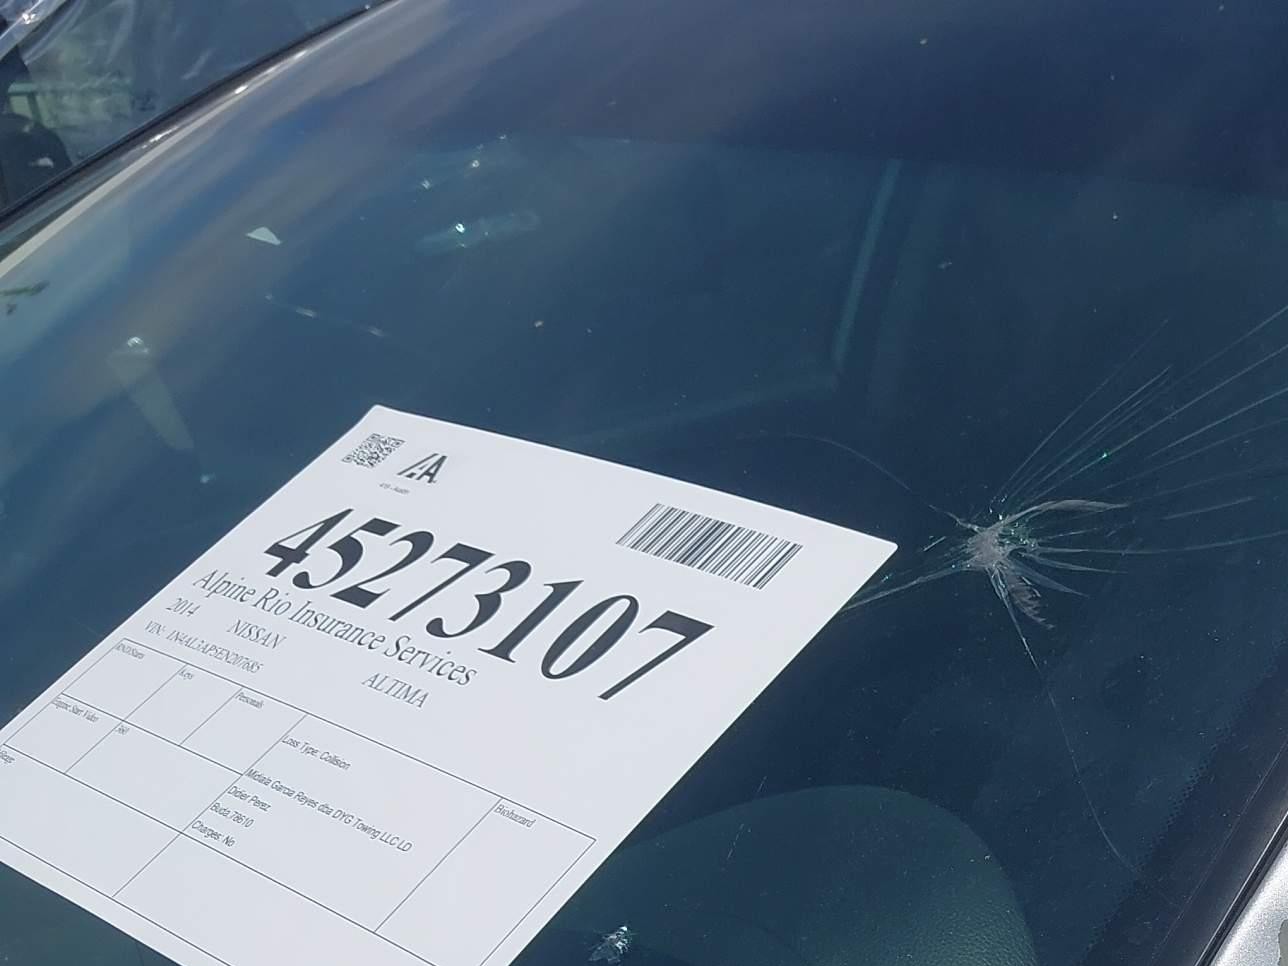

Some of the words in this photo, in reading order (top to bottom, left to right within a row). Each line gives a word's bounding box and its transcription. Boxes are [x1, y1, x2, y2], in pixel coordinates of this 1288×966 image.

[263, 507, 715, 701] 45273107
[145, 620, 166, 636] VIN:
[193, 569, 256, 606] Alpine
[252, 588, 291, 616] Rio
[288, 601, 385, 650] Insurance
[384, 635, 478, 687] Services
[166, 597, 201, 619] 2014
[226, 619, 288, 650] NISSAN
[361, 672, 431, 709] ALTIMA
[281, 734, 301, 748] Loss
[320, 751, 351, 770] Collision
[227, 785, 251, 801] Didier
[248, 795, 272, 812] Perez
[270, 780, 295, 798] Garcia
[293, 791, 319, 809] Reyes
[317, 802, 333, 816] dba
[332, 808, 354, 825] DYG
[352, 818, 381, 840] Towing
[379, 831, 399, 846] LLC
[397, 841, 413, 852] LD
[493, 803, 537, 828] Biohazard
[222, 835, 236, 847] No
